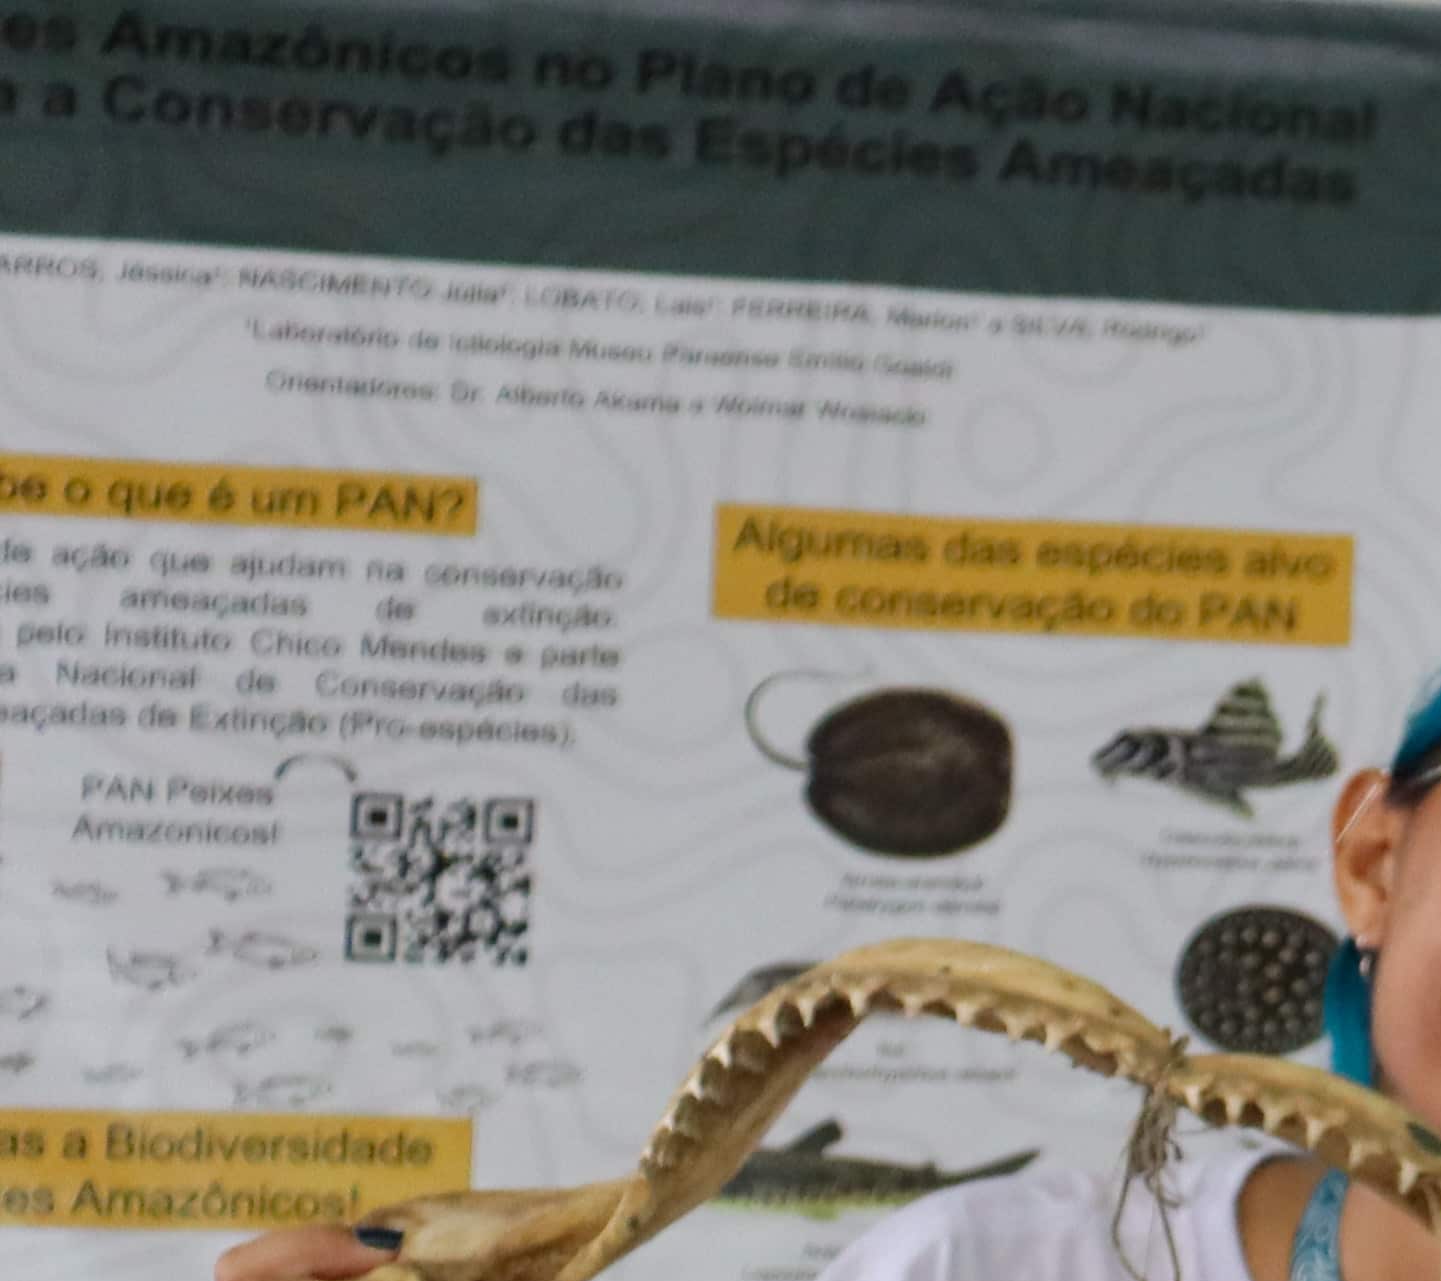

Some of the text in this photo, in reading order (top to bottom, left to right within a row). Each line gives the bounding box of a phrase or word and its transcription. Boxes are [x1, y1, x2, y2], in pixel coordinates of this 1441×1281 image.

[534, 45, 615, 90] no
[636, 46, 816, 106] Plano
[835, 62, 909, 112] de
[931, 66, 1089, 127] Ação
[1111, 78, 1378, 146] Nacional
[103, 74, 537, 158] Conservação
[558, 108, 672, 157] das
[695, 112, 978, 181] Espécies
[1000, 134, 1359, 206] Ameaçadas
[63, 478, 91, 504] o
[107, 478, 193, 518] que
[207, 475, 234, 513] é
[250, 484, 321, 517] um
[335, 482, 466, 522] PAN?
[51, 542, 130, 573] ação
[150, 549, 210, 577] que
[229, 551, 345, 582] ajudam
[365, 558, 405, 583] na
[423, 559, 623, 596] conservação
[733, 515, 1335, 581] Algumas das espécies alvo
[120, 584, 308, 619] ameaçadas
[375, 596, 416, 623] de
[763, 574, 1297, 635] de conservação do PAN
[16, 620, 87, 649] pelo
[105, 621, 232, 654] Instituto
[249, 628, 343, 659] Chico
[359, 635, 487, 667] Mendes
[541, 641, 621, 671] parte
[56, 659, 619, 710] Nacional de Conservação das
[137, 703, 178, 730] de
[188, 703, 329, 740] Extinção
[81, 773, 275, 807] PAN Peixes
[62, 1133, 88, 1160] a
[104, 1124, 434, 1167] Biodiversidade
[70, 1179, 359, 1221] Amazônicos!
